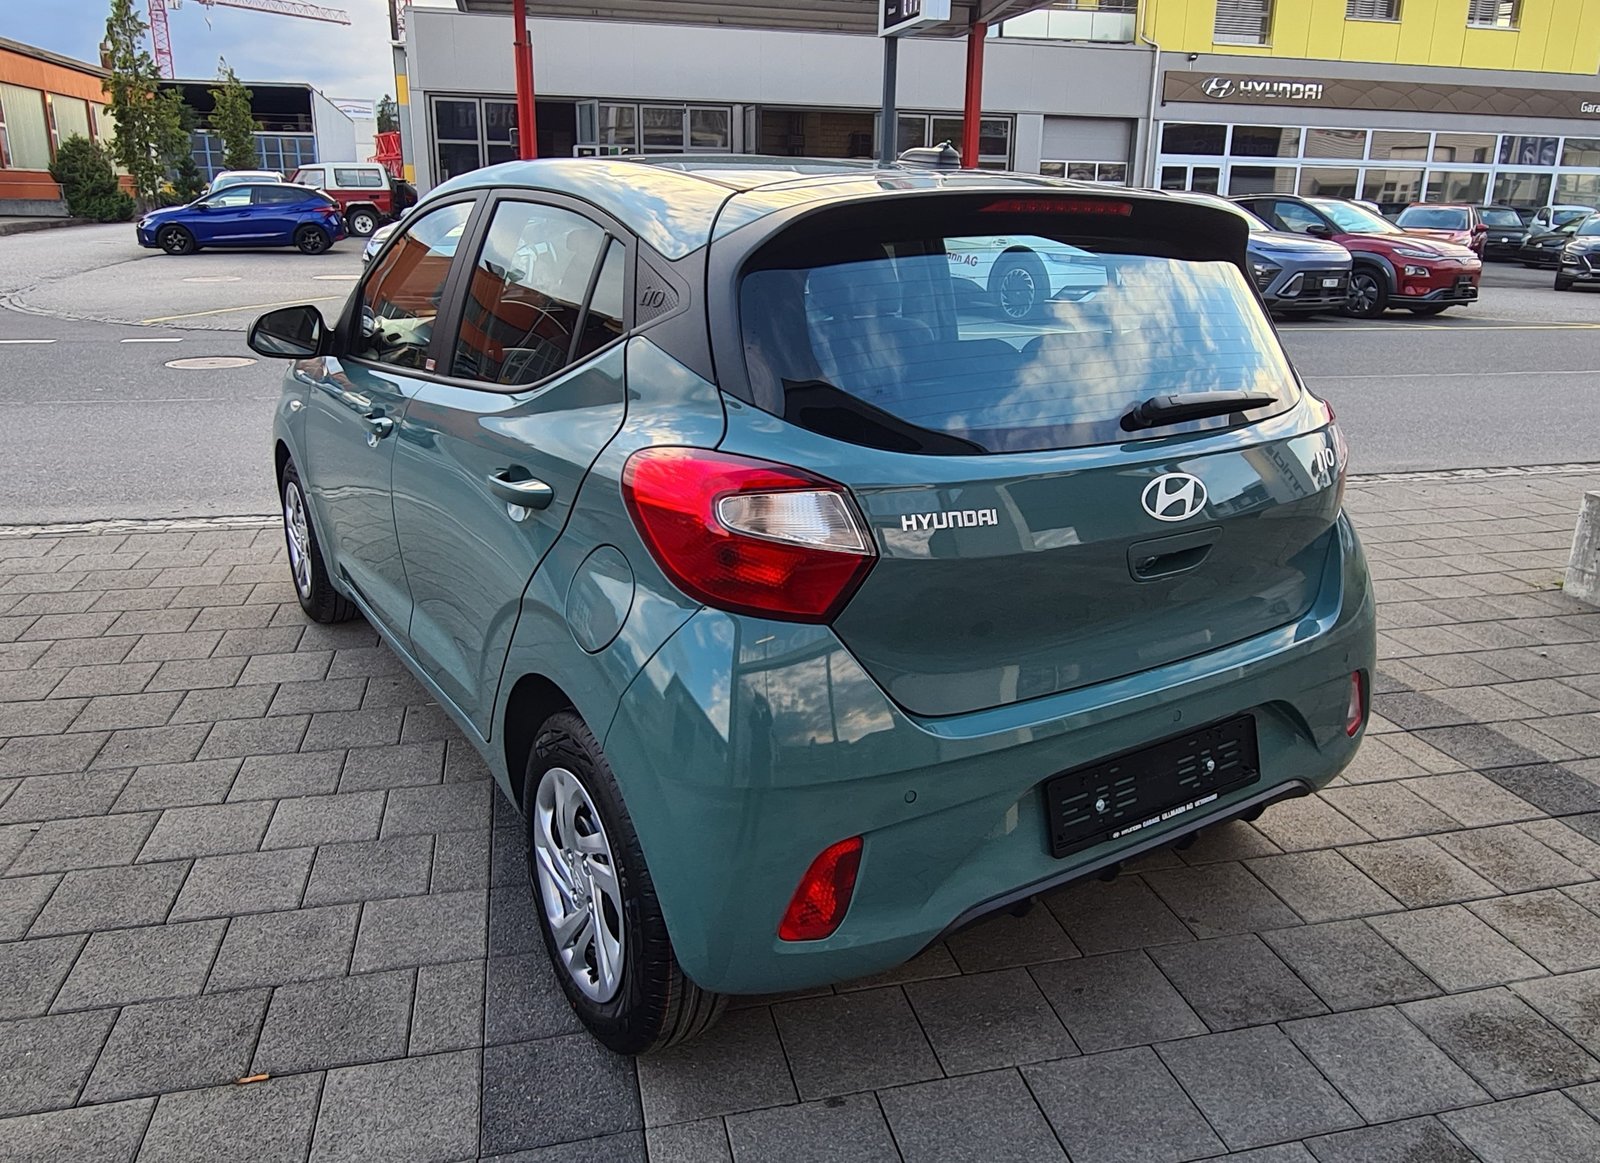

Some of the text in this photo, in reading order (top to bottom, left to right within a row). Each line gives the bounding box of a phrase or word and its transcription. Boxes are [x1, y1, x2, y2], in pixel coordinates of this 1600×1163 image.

[1239, 80, 1323, 100] HYUNDAI
[963, 254, 978, 267] AG
[639, 285, 666, 308] i10
[901, 508, 998, 532] HYUNDAI
[1161, 805, 1186, 820] ULLMANN
